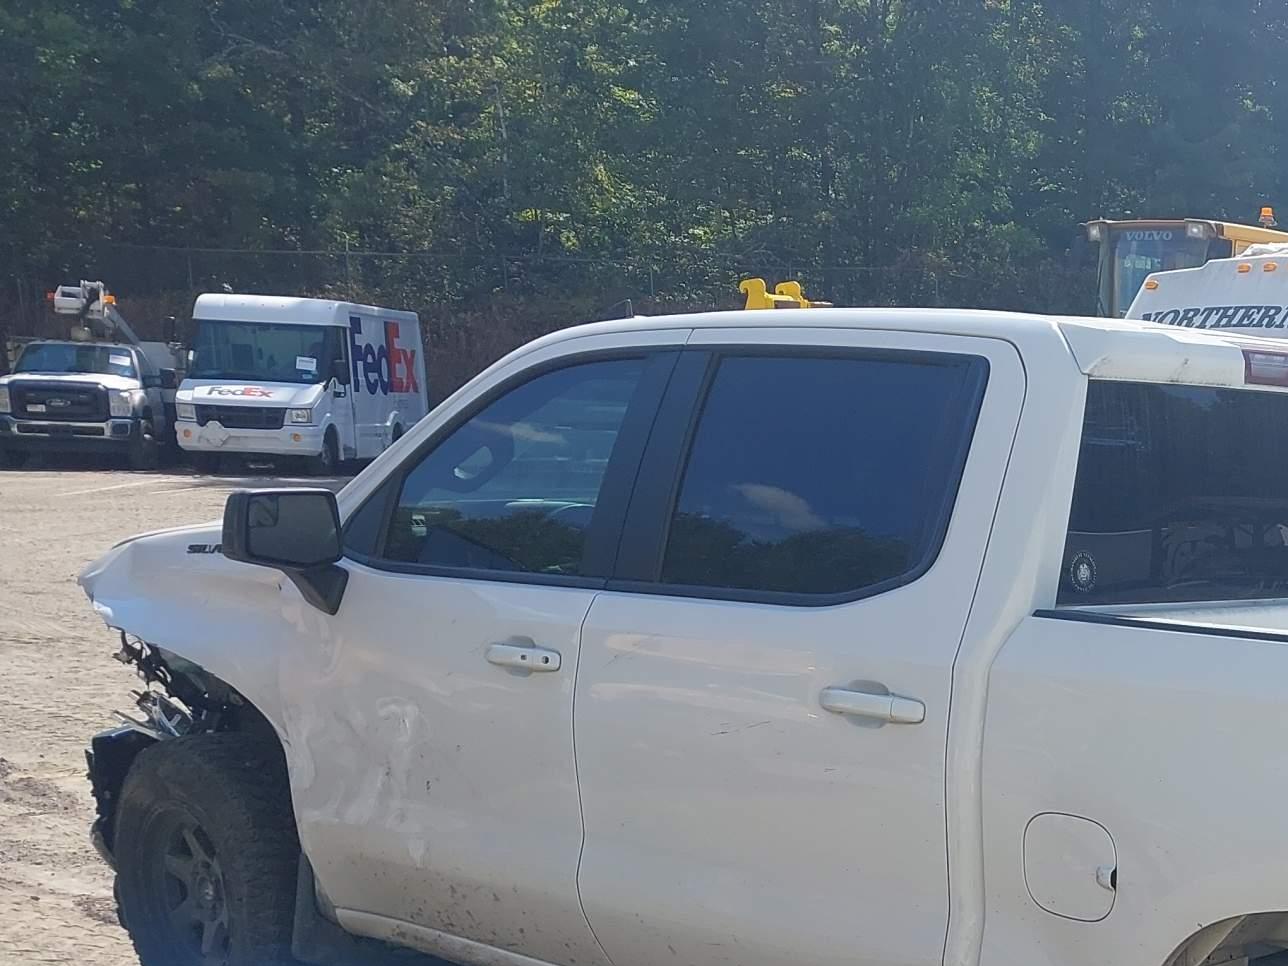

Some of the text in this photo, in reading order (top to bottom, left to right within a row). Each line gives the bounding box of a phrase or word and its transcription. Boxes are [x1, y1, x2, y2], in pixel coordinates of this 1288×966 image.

[1126, 231, 1172, 241] VOLVO
[350, 316, 418, 395] FedEx
[207, 386, 272, 398] FedEx
